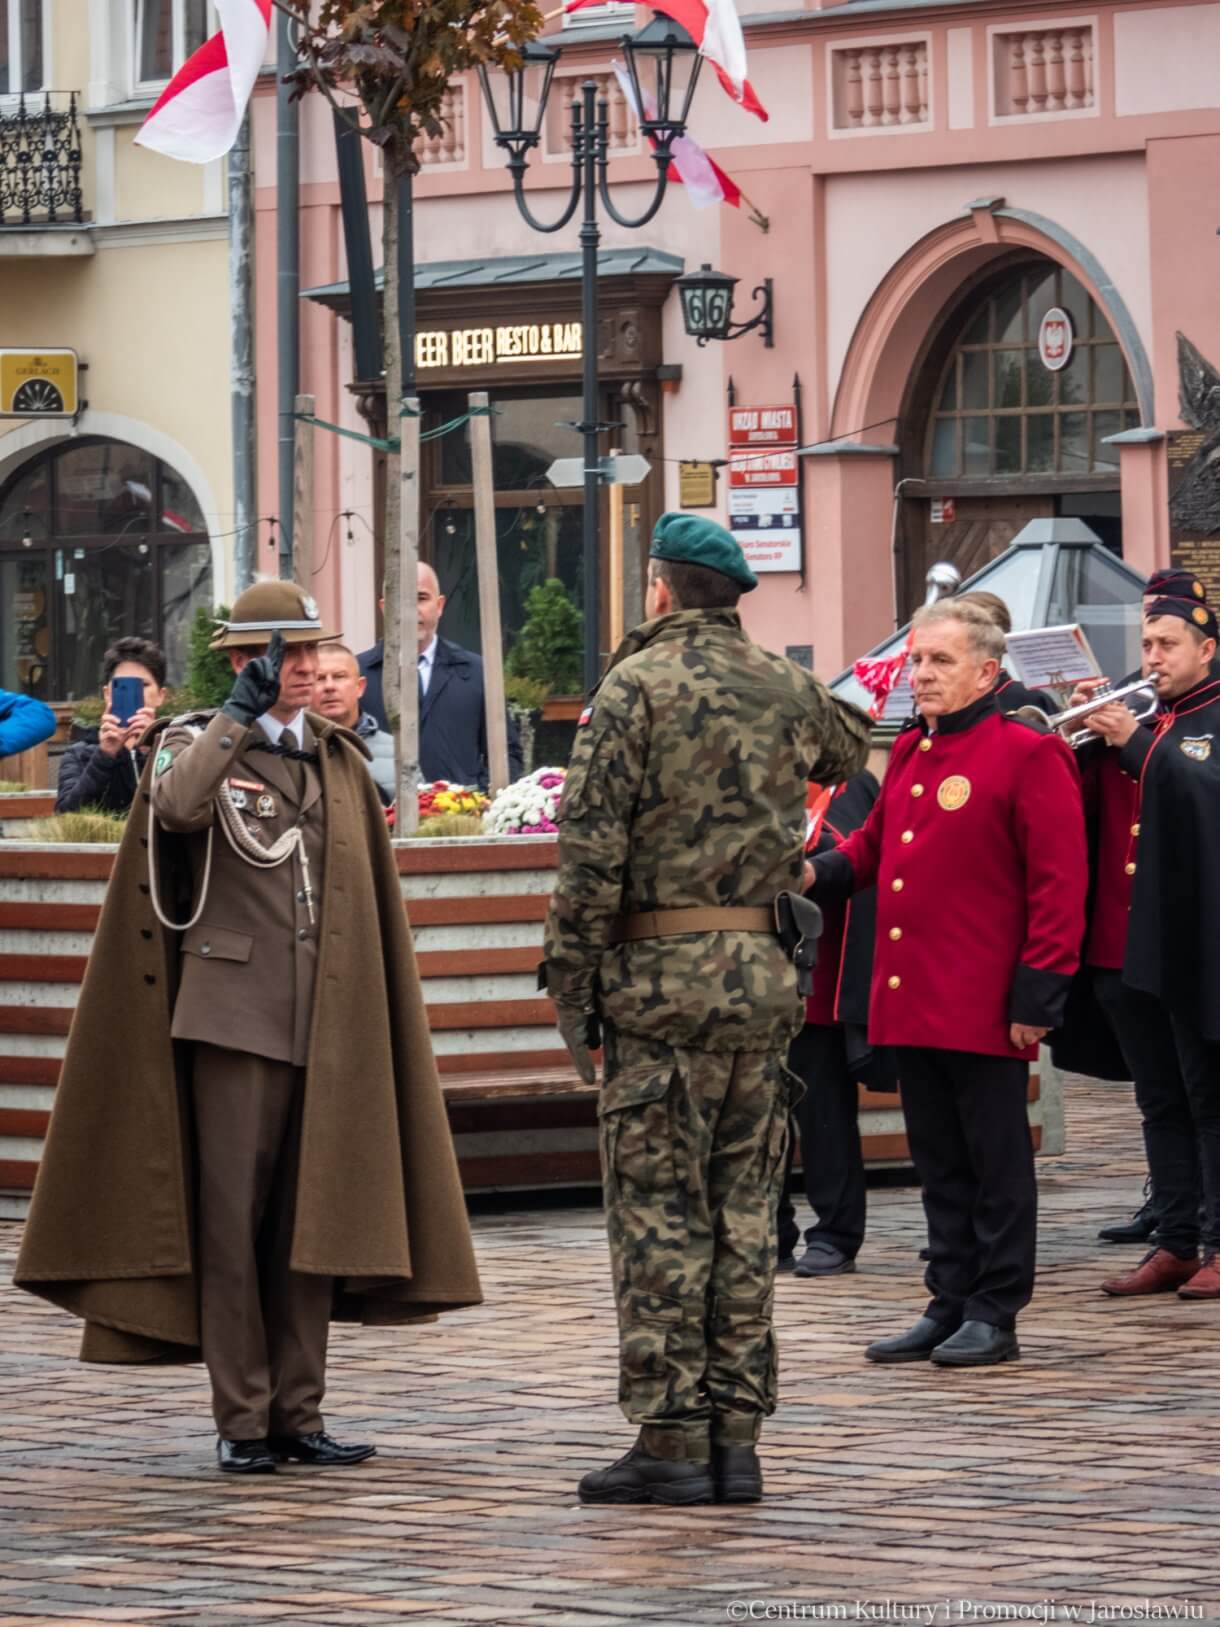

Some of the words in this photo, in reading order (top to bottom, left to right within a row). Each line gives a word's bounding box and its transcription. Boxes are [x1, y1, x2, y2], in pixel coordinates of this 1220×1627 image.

[689, 293, 724, 324] 66
[416, 331, 449, 368] EER
[452, 328, 495, 367] BEER
[496, 325, 539, 355] RESTO
[541, 324, 552, 353] &
[553, 322, 582, 352] BAR
